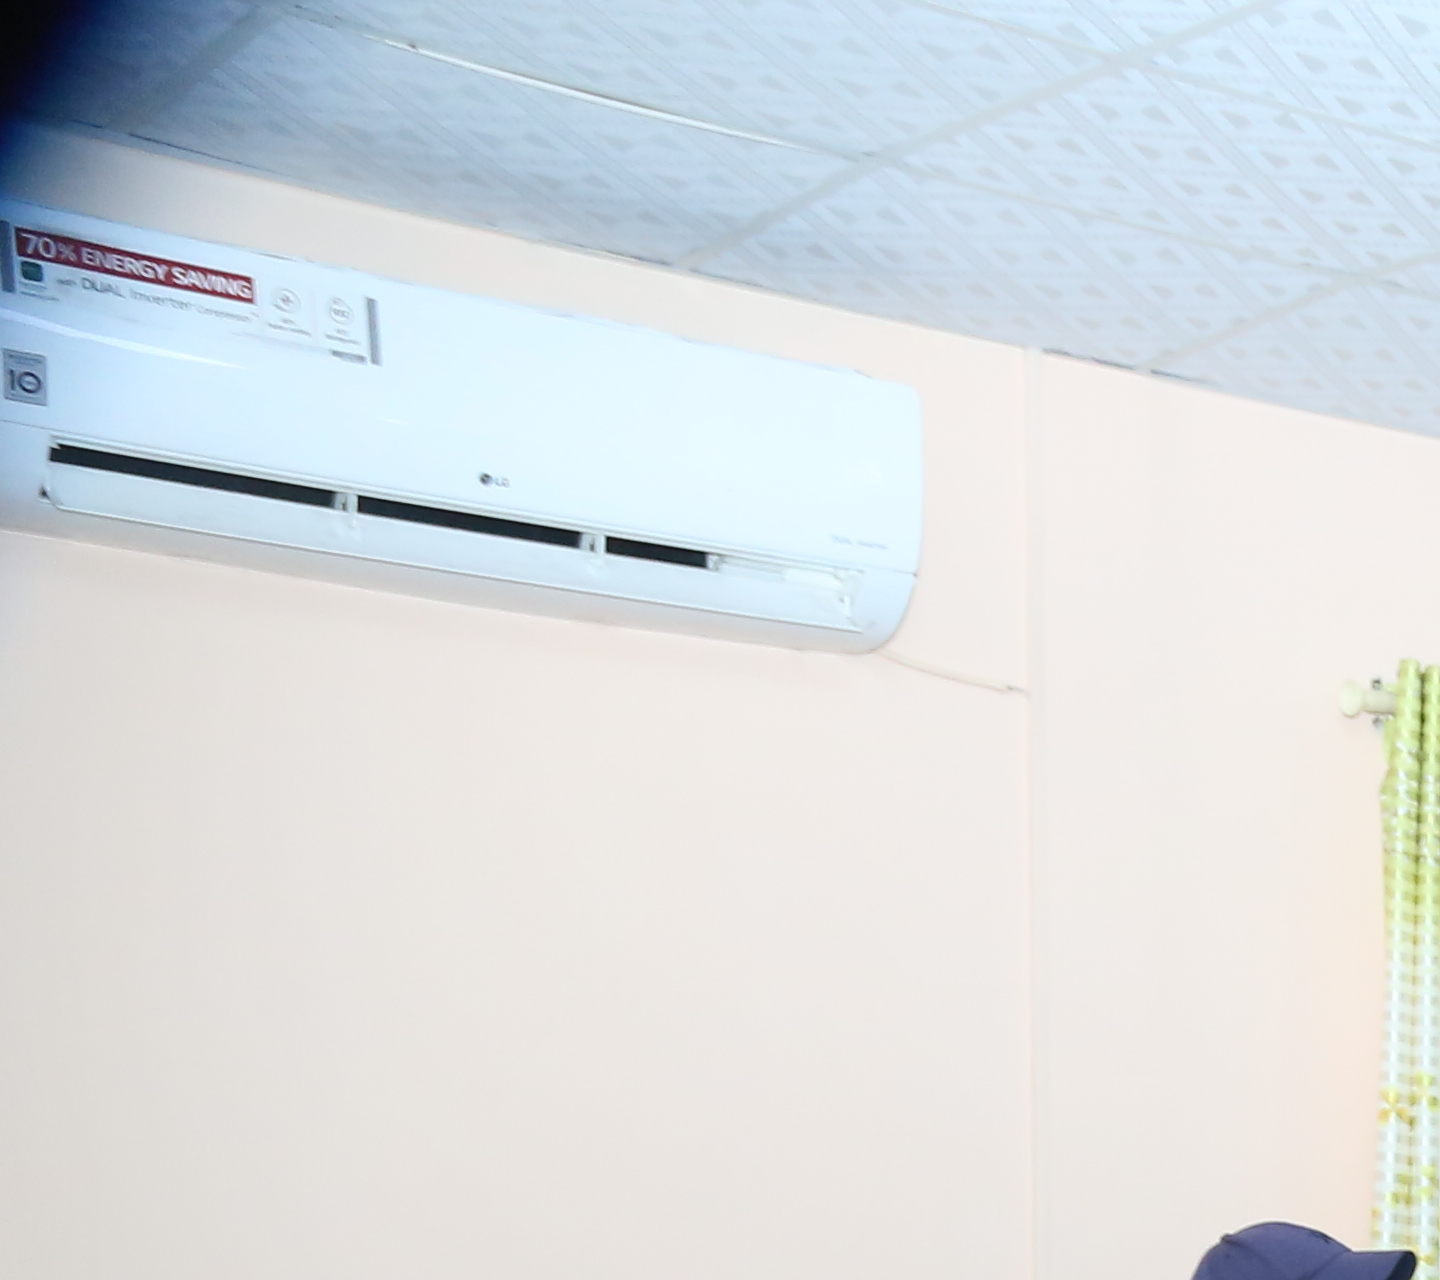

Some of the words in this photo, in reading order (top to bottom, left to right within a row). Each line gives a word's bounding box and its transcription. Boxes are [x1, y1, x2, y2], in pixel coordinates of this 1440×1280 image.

[20, 233, 77, 261] 70%
[81, 248, 169, 281] ENERGY
[172, 267, 253, 299] SAVING
